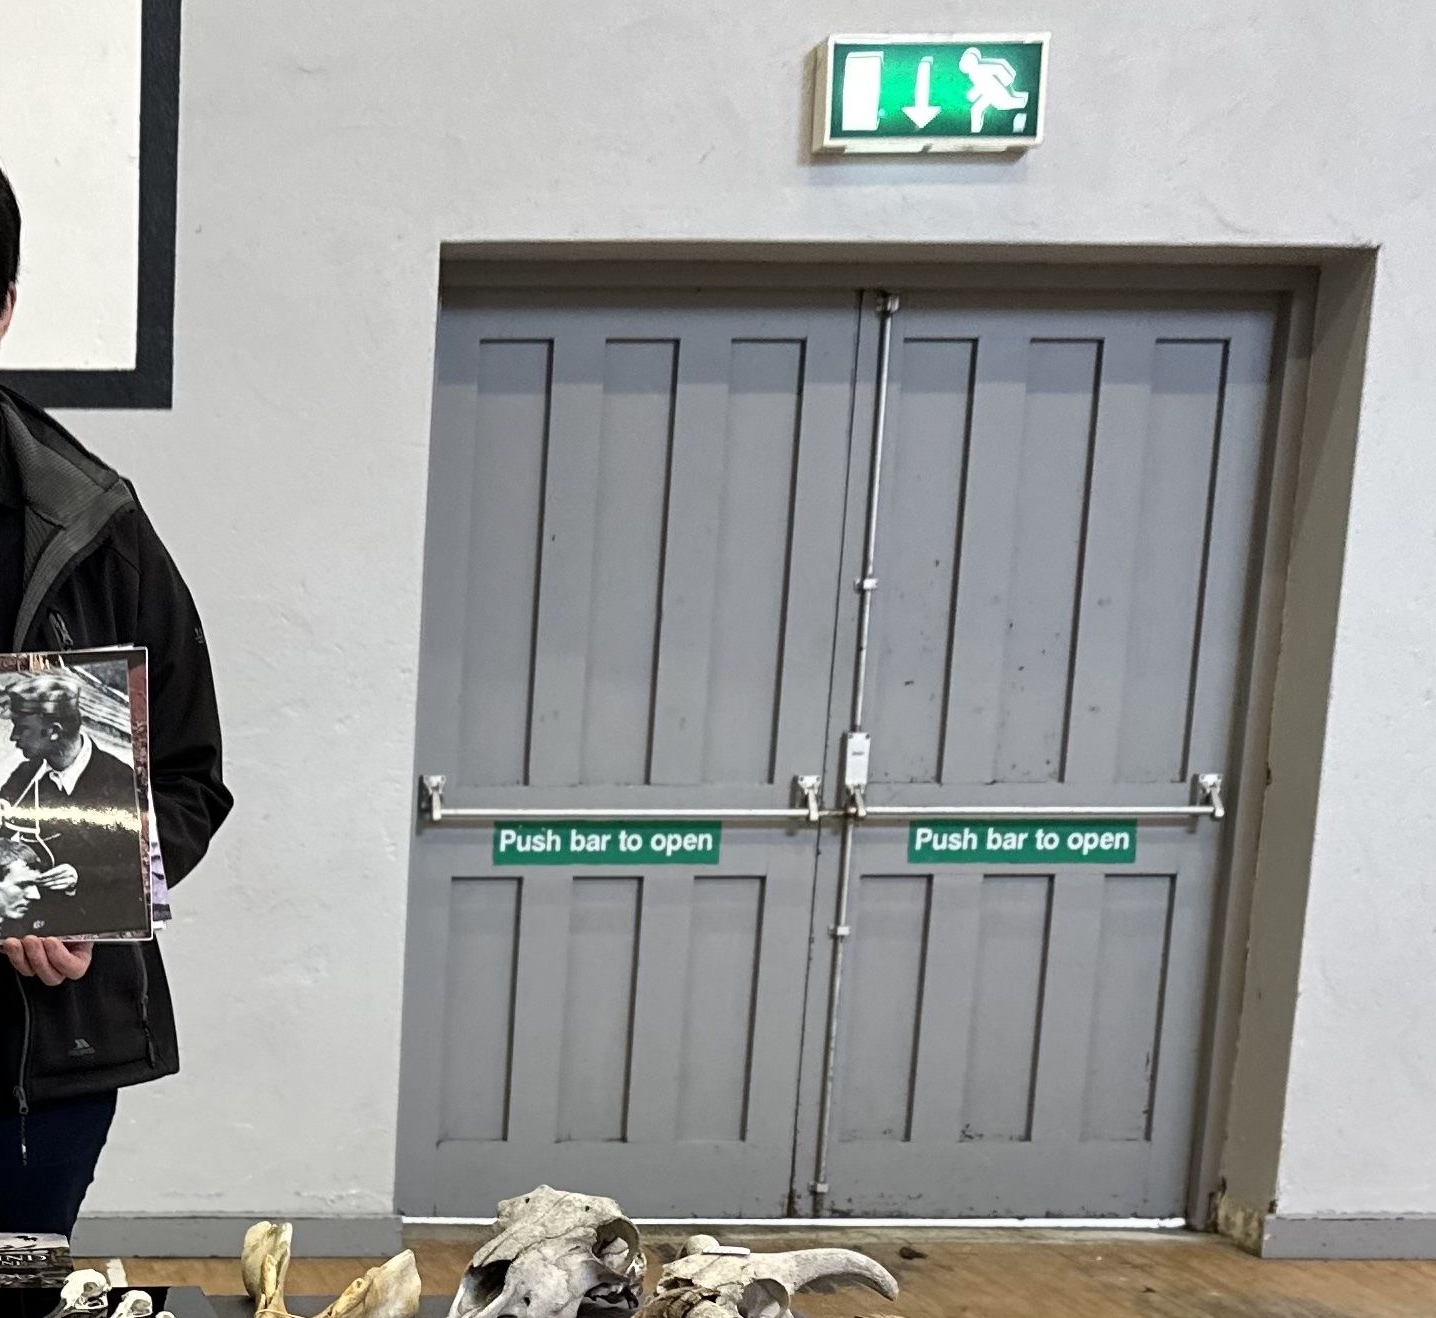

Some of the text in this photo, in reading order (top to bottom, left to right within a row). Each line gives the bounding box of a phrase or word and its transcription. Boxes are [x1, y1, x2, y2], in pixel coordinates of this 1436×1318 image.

[499, 829, 713, 857] Push bar to open
[914, 827, 1129, 855] Push bar to open
